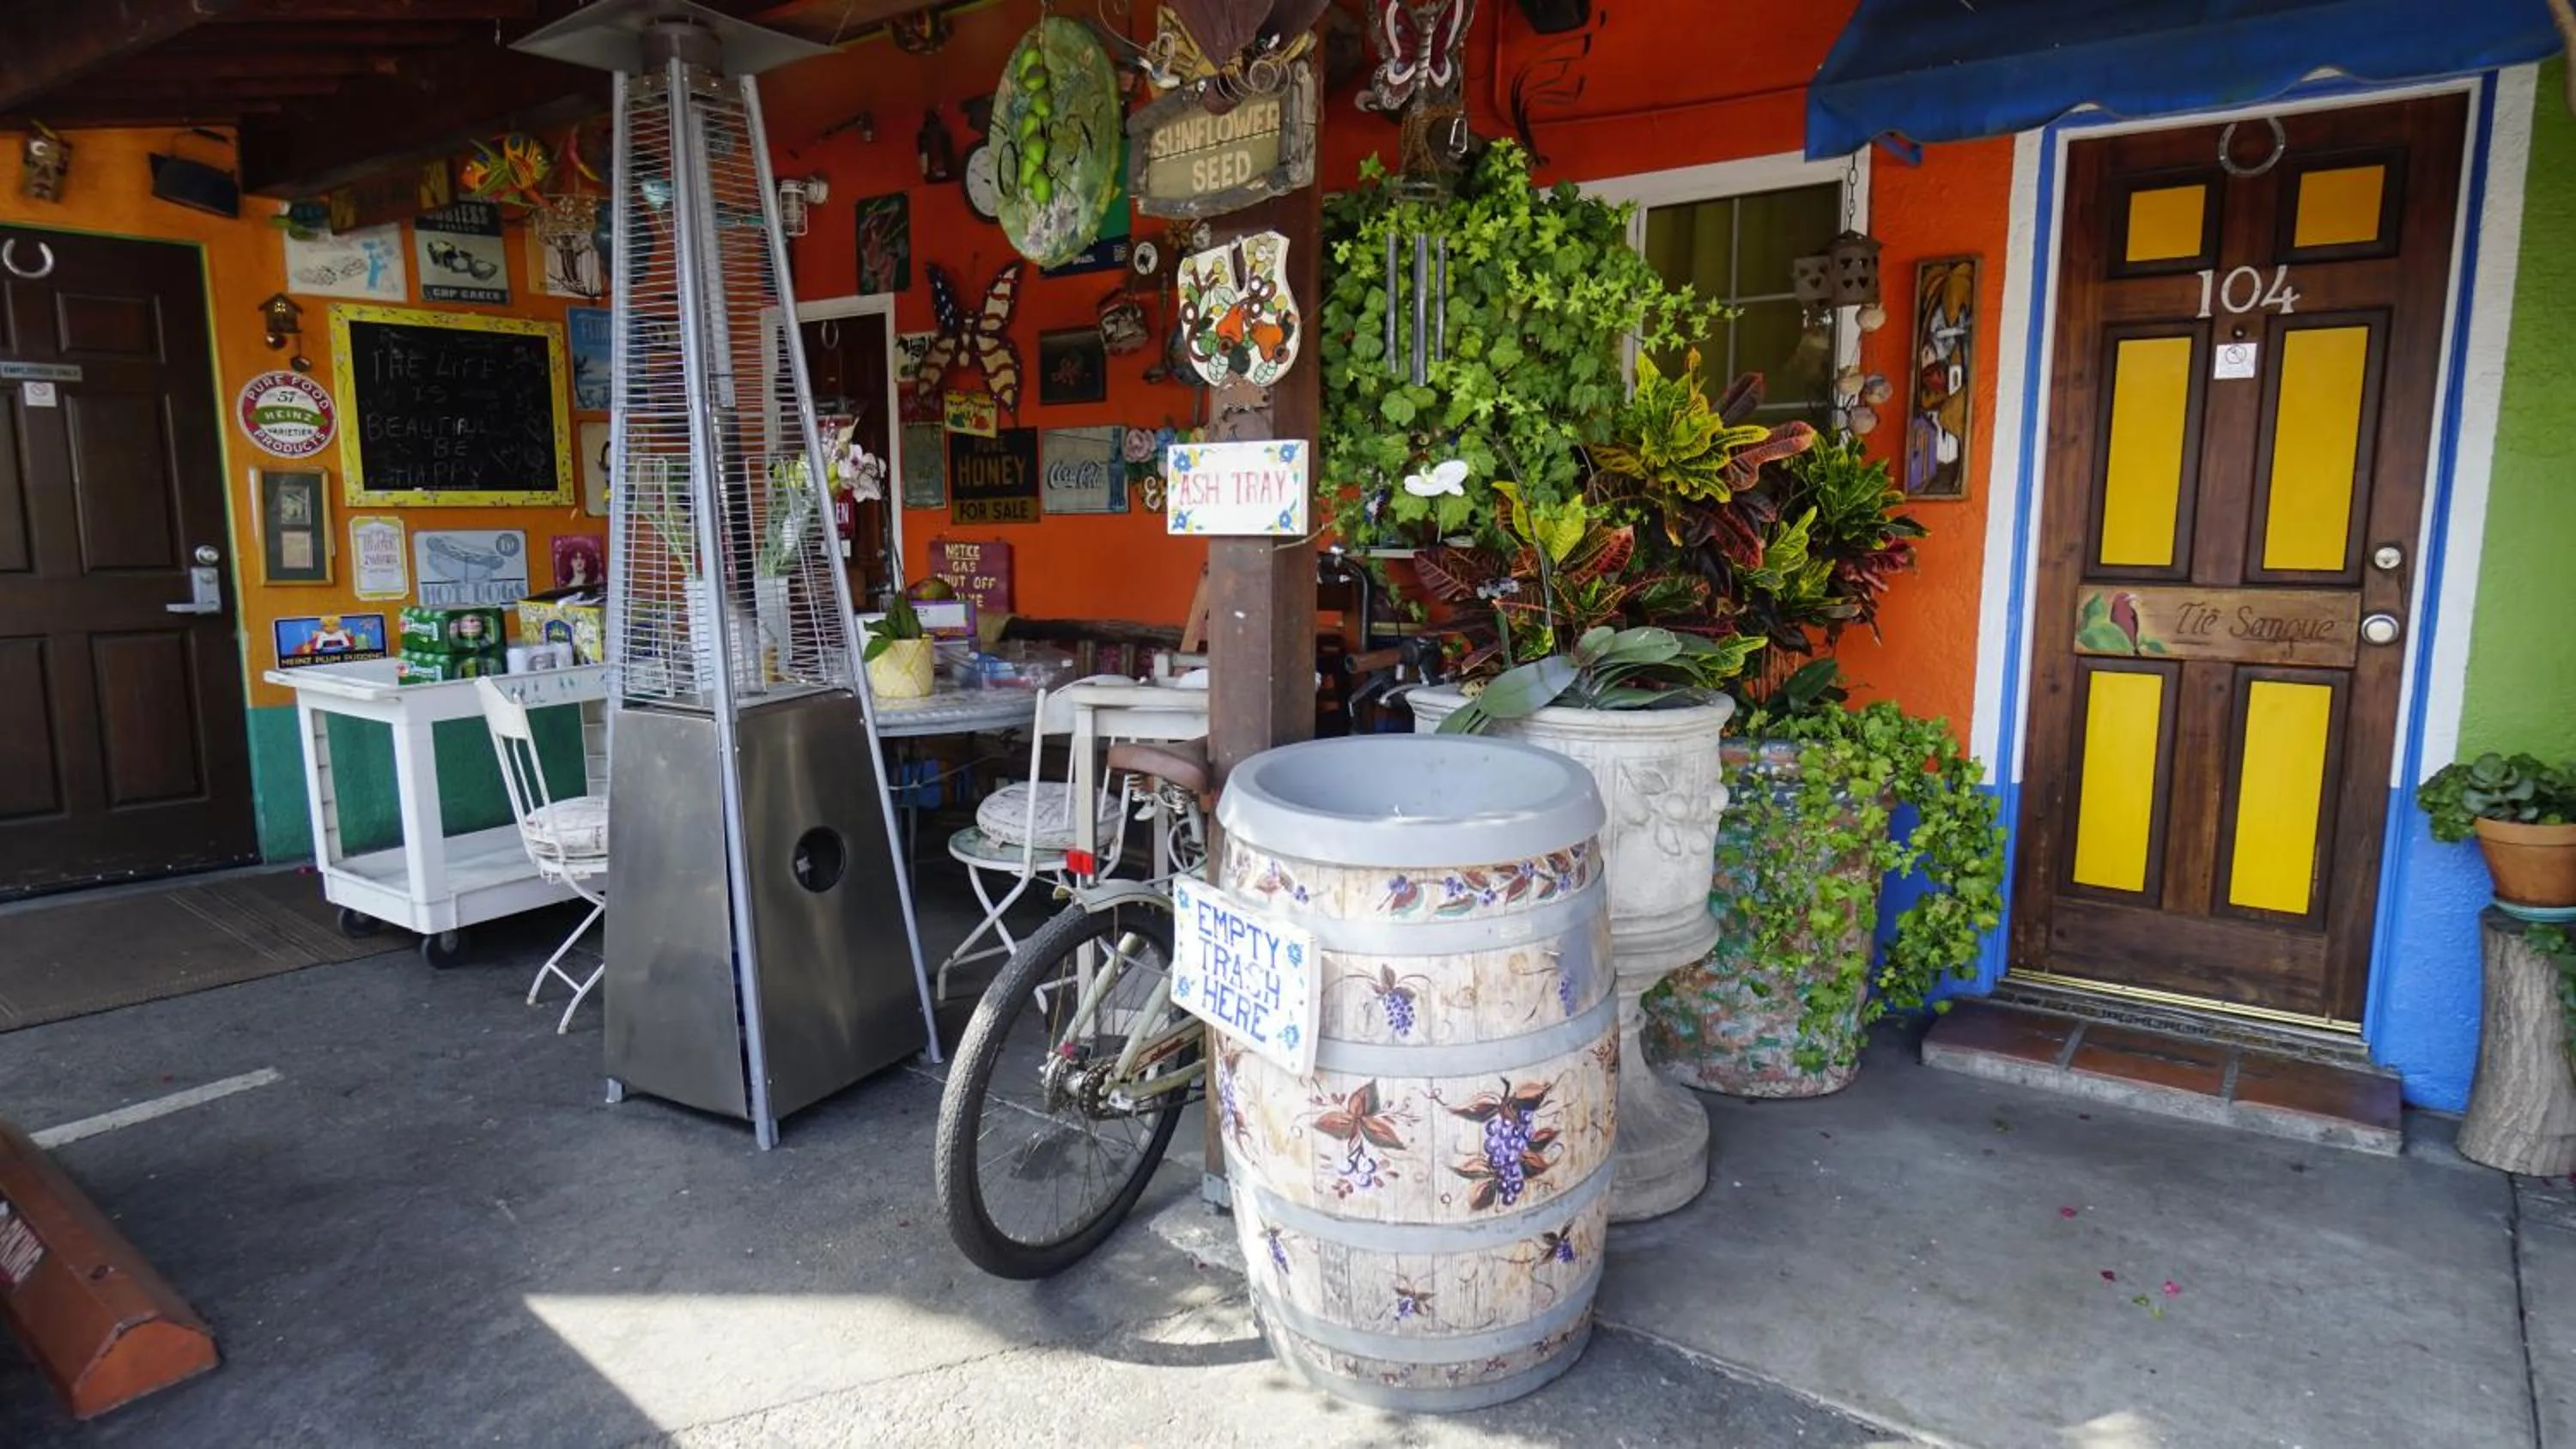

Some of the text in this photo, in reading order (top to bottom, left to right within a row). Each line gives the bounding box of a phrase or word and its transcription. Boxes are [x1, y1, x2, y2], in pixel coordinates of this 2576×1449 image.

[1152, 100, 1281, 163] SUNFLOWER
[1192, 150, 1252, 193] SEED
[2196, 264, 2301, 318] 104
[373, 347, 428, 384] THE
[246, 375, 330, 409] PURE FOOD
[277, 391, 296, 403] 57
[264, 409, 313, 422] HEINZ
[254, 429, 326, 453] PRODUCTS
[433, 437, 469, 458] BE
[957, 455, 1027, 488] HONEY
[1180, 470, 1288, 505] ASH TRAY
[959, 500, 1029, 521] FOR SALE
[952, 561, 976, 573] GAS
[973, 576, 997, 590] OFF
[422, 581, 526, 605] HOT DOGS
[2228, 605, 2336, 658] Sangue
[1197, 900, 1279, 968] EMPTY
[1198, 937, 1280, 1010] TRASH
[1202, 975, 1269, 1043] HERE
